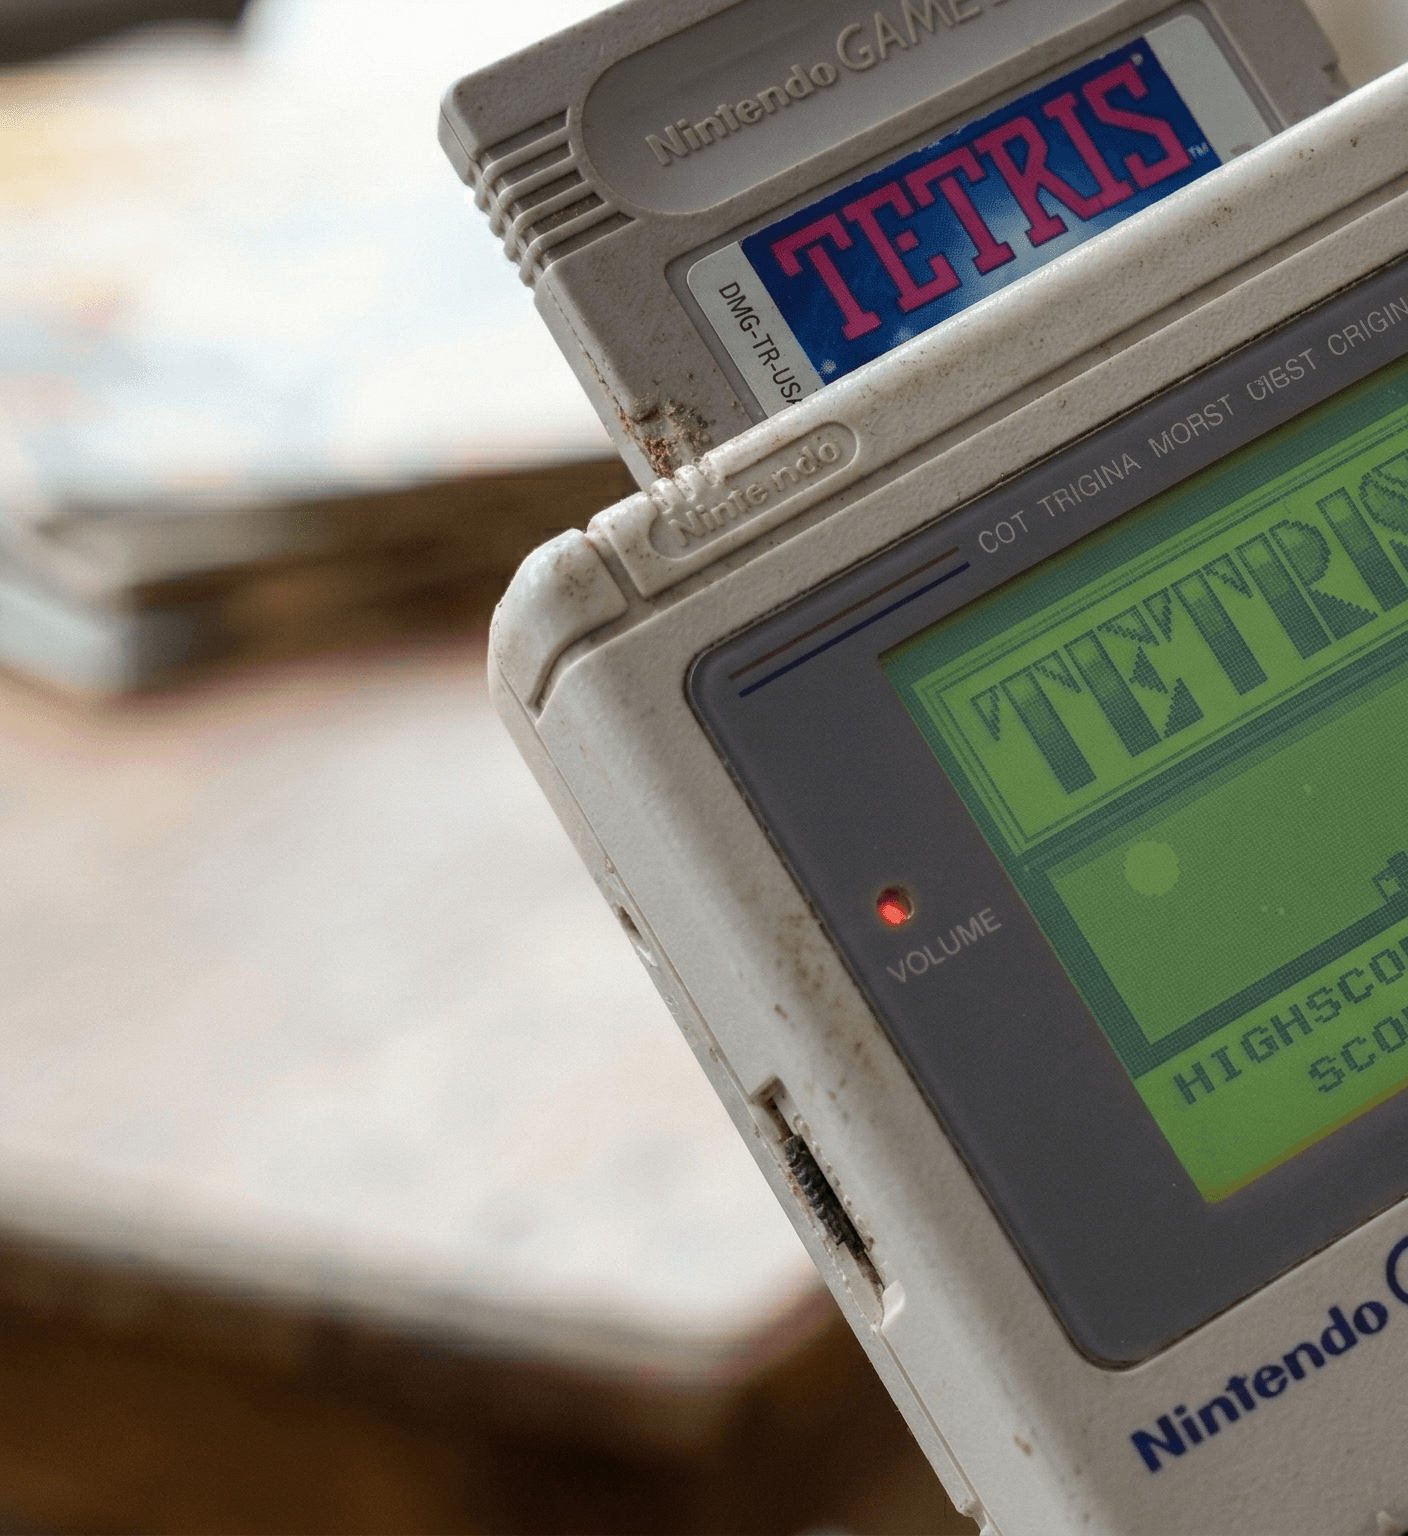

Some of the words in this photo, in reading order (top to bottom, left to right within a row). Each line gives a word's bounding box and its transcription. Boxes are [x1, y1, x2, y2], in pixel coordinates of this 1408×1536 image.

[645, 60, 838, 167] Nintendo
[771, 60, 1192, 341] TETRIS
[978, 510, 1031, 554] COT
[1036, 452, 1142, 518] TRIGINA
[886, 907, 1002, 983] VOLUME
[1128, 1298, 1389, 1473] Nintendo
